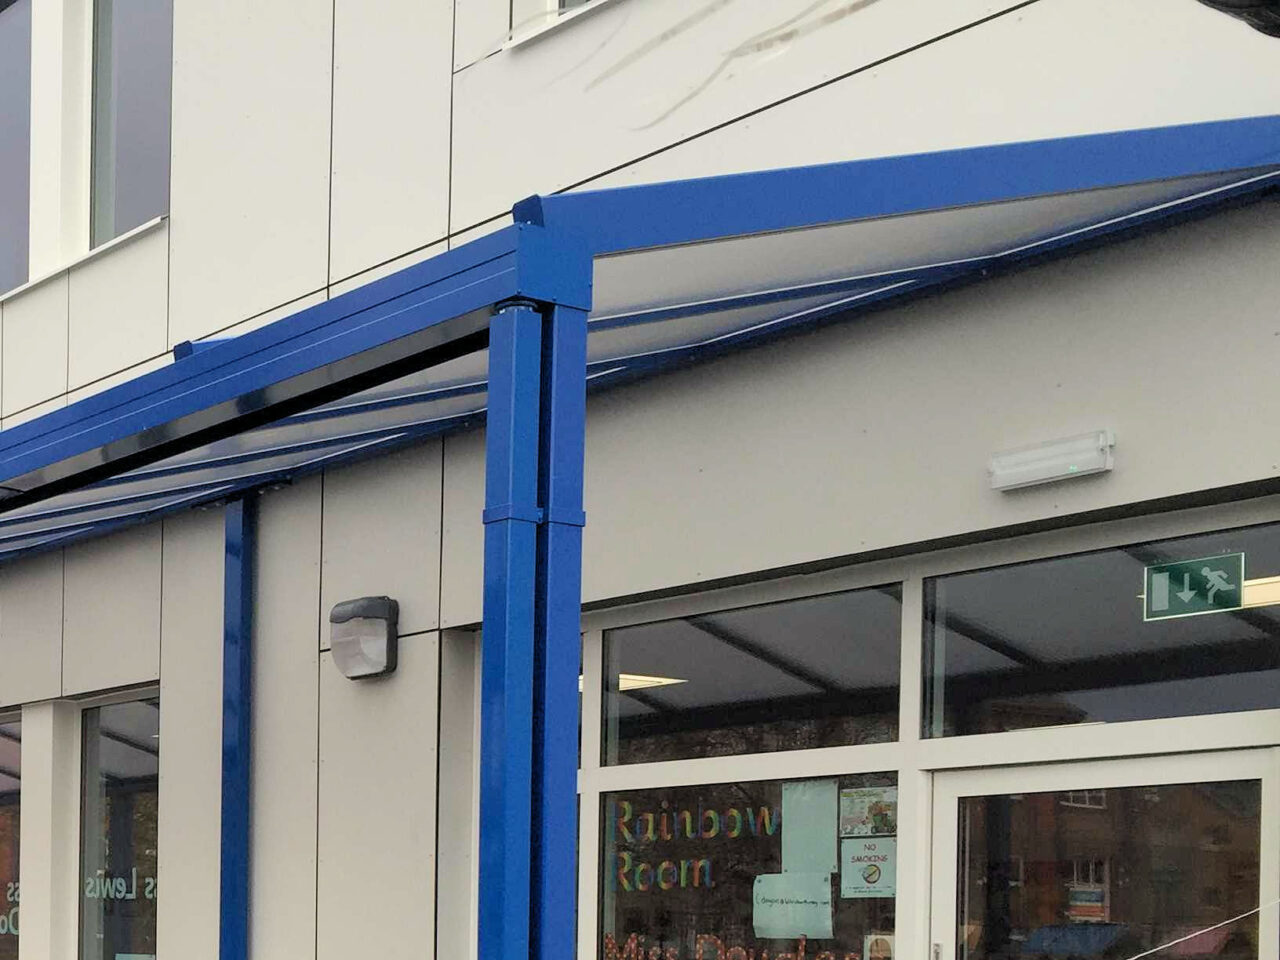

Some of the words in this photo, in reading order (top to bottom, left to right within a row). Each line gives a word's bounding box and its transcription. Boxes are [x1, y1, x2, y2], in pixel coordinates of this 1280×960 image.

[611, 799, 780, 842] Rainbow
[851, 854, 888, 863] SMOKING
[864, 843, 877, 851] NO
[611, 851, 716, 891] Room
